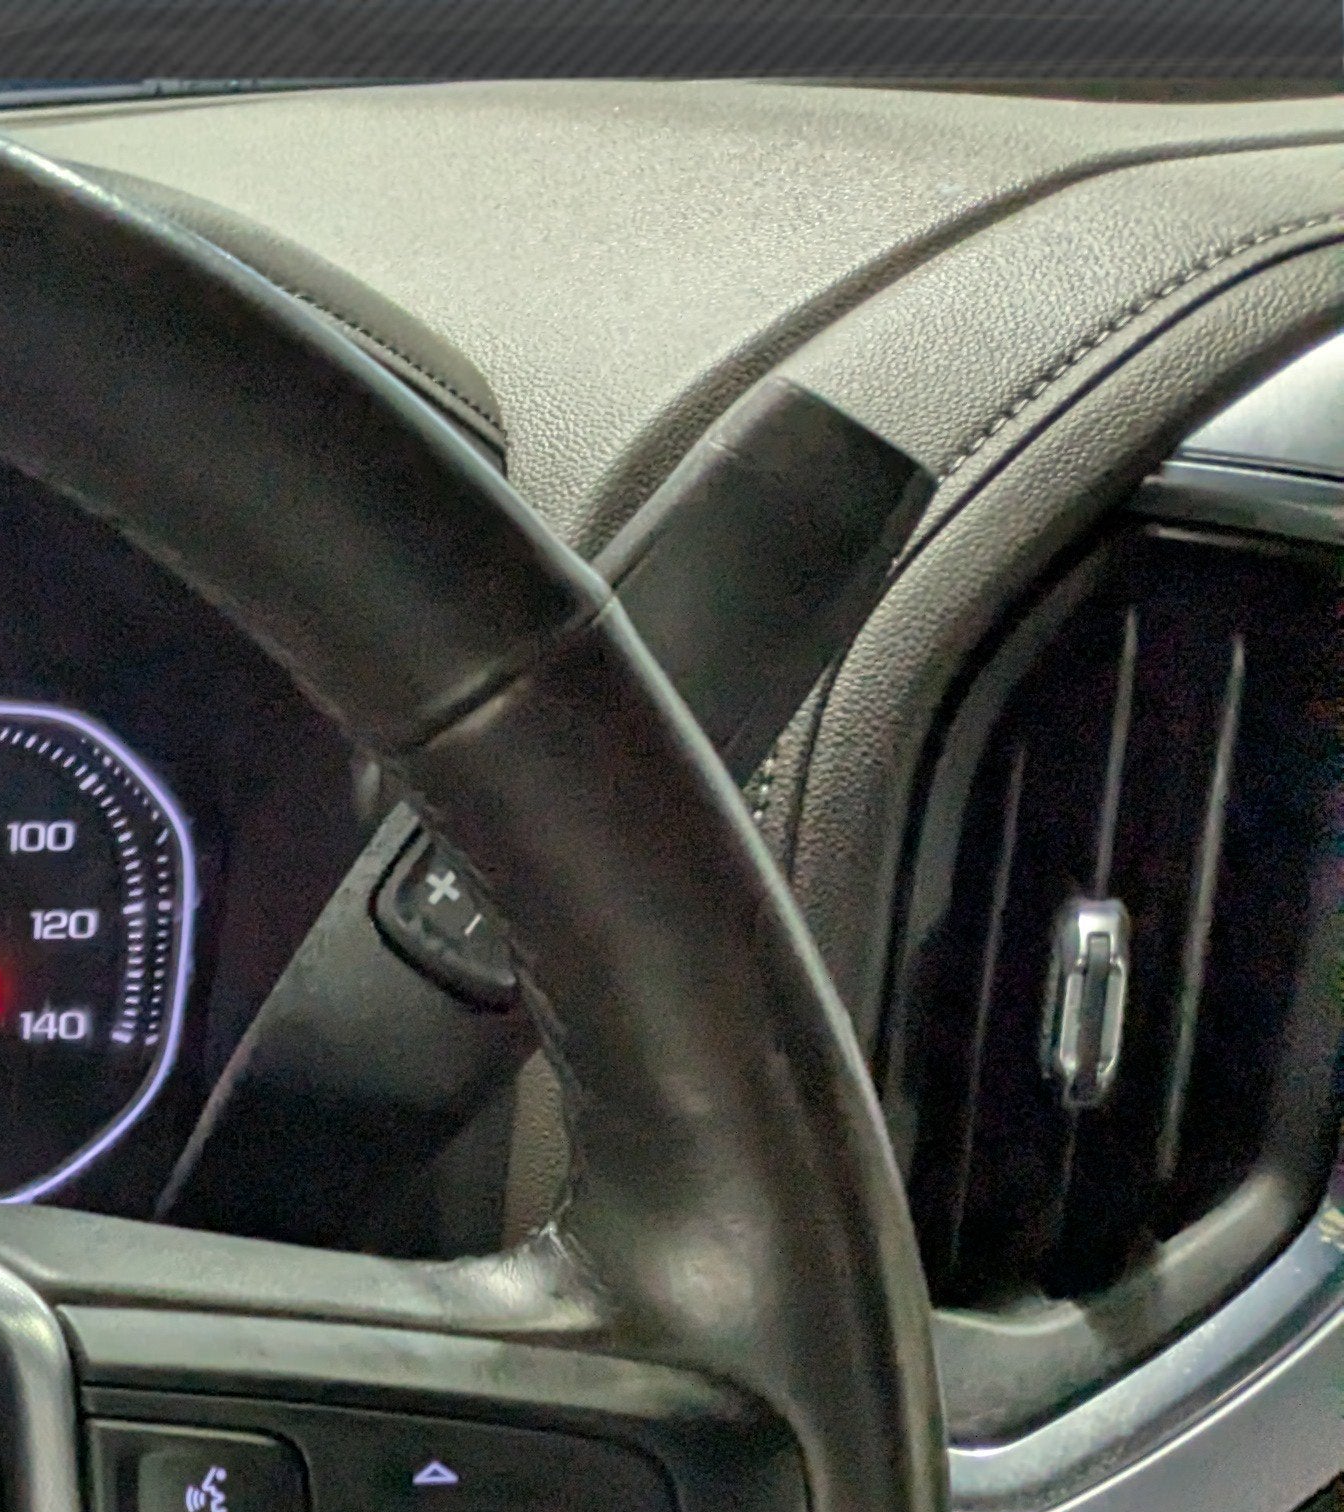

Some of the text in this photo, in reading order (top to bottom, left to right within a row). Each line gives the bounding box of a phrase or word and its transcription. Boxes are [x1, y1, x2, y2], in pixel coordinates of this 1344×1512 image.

[7, 821, 76, 853] 100
[30, 908, 98, 941] 120
[19, 1009, 88, 1042] 140
